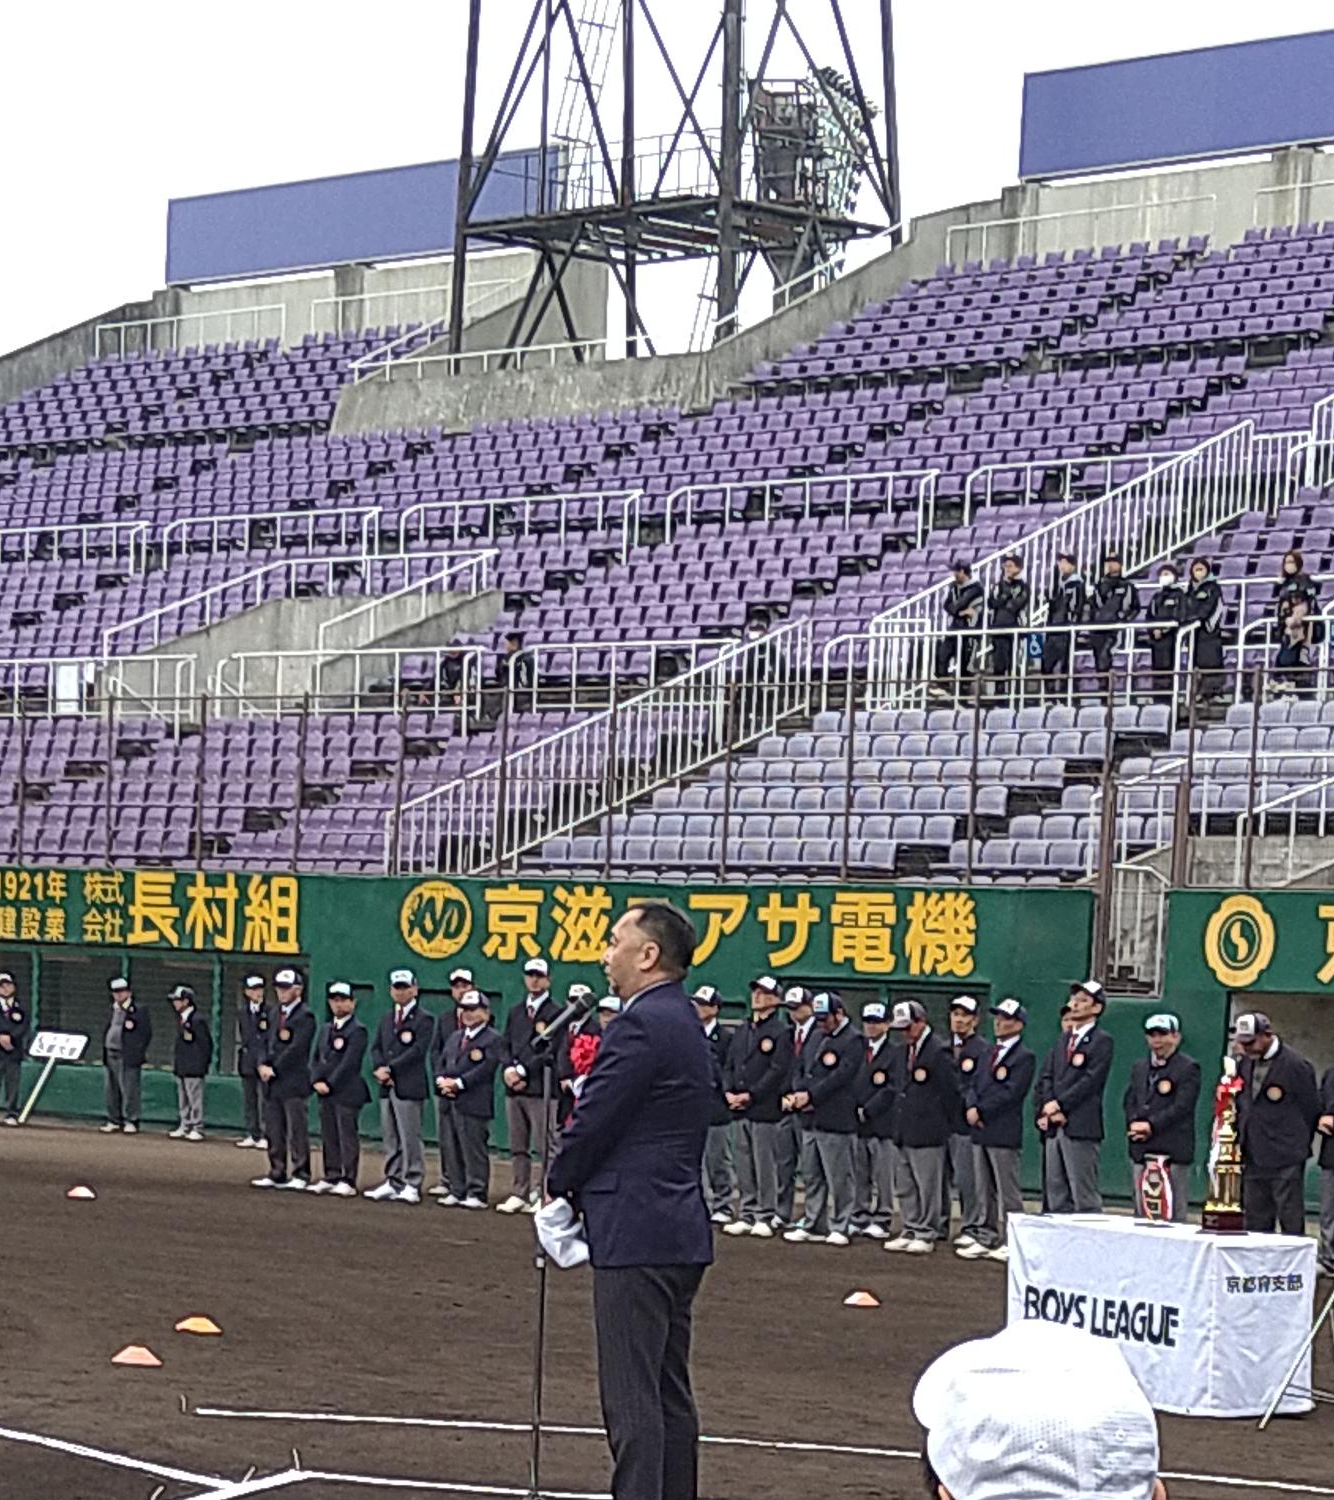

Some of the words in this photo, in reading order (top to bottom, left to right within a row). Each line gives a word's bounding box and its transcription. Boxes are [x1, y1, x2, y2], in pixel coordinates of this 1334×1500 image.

[83, 871, 124, 906] 株式
[127, 871, 299, 954] 長村組
[82, 907, 124, 943] 会社
[482, 883, 976, 976] 京滋アサ電機
[1023, 1284, 1087, 1329] BOYS
[1090, 1297, 1180, 1347] LEAGUE
